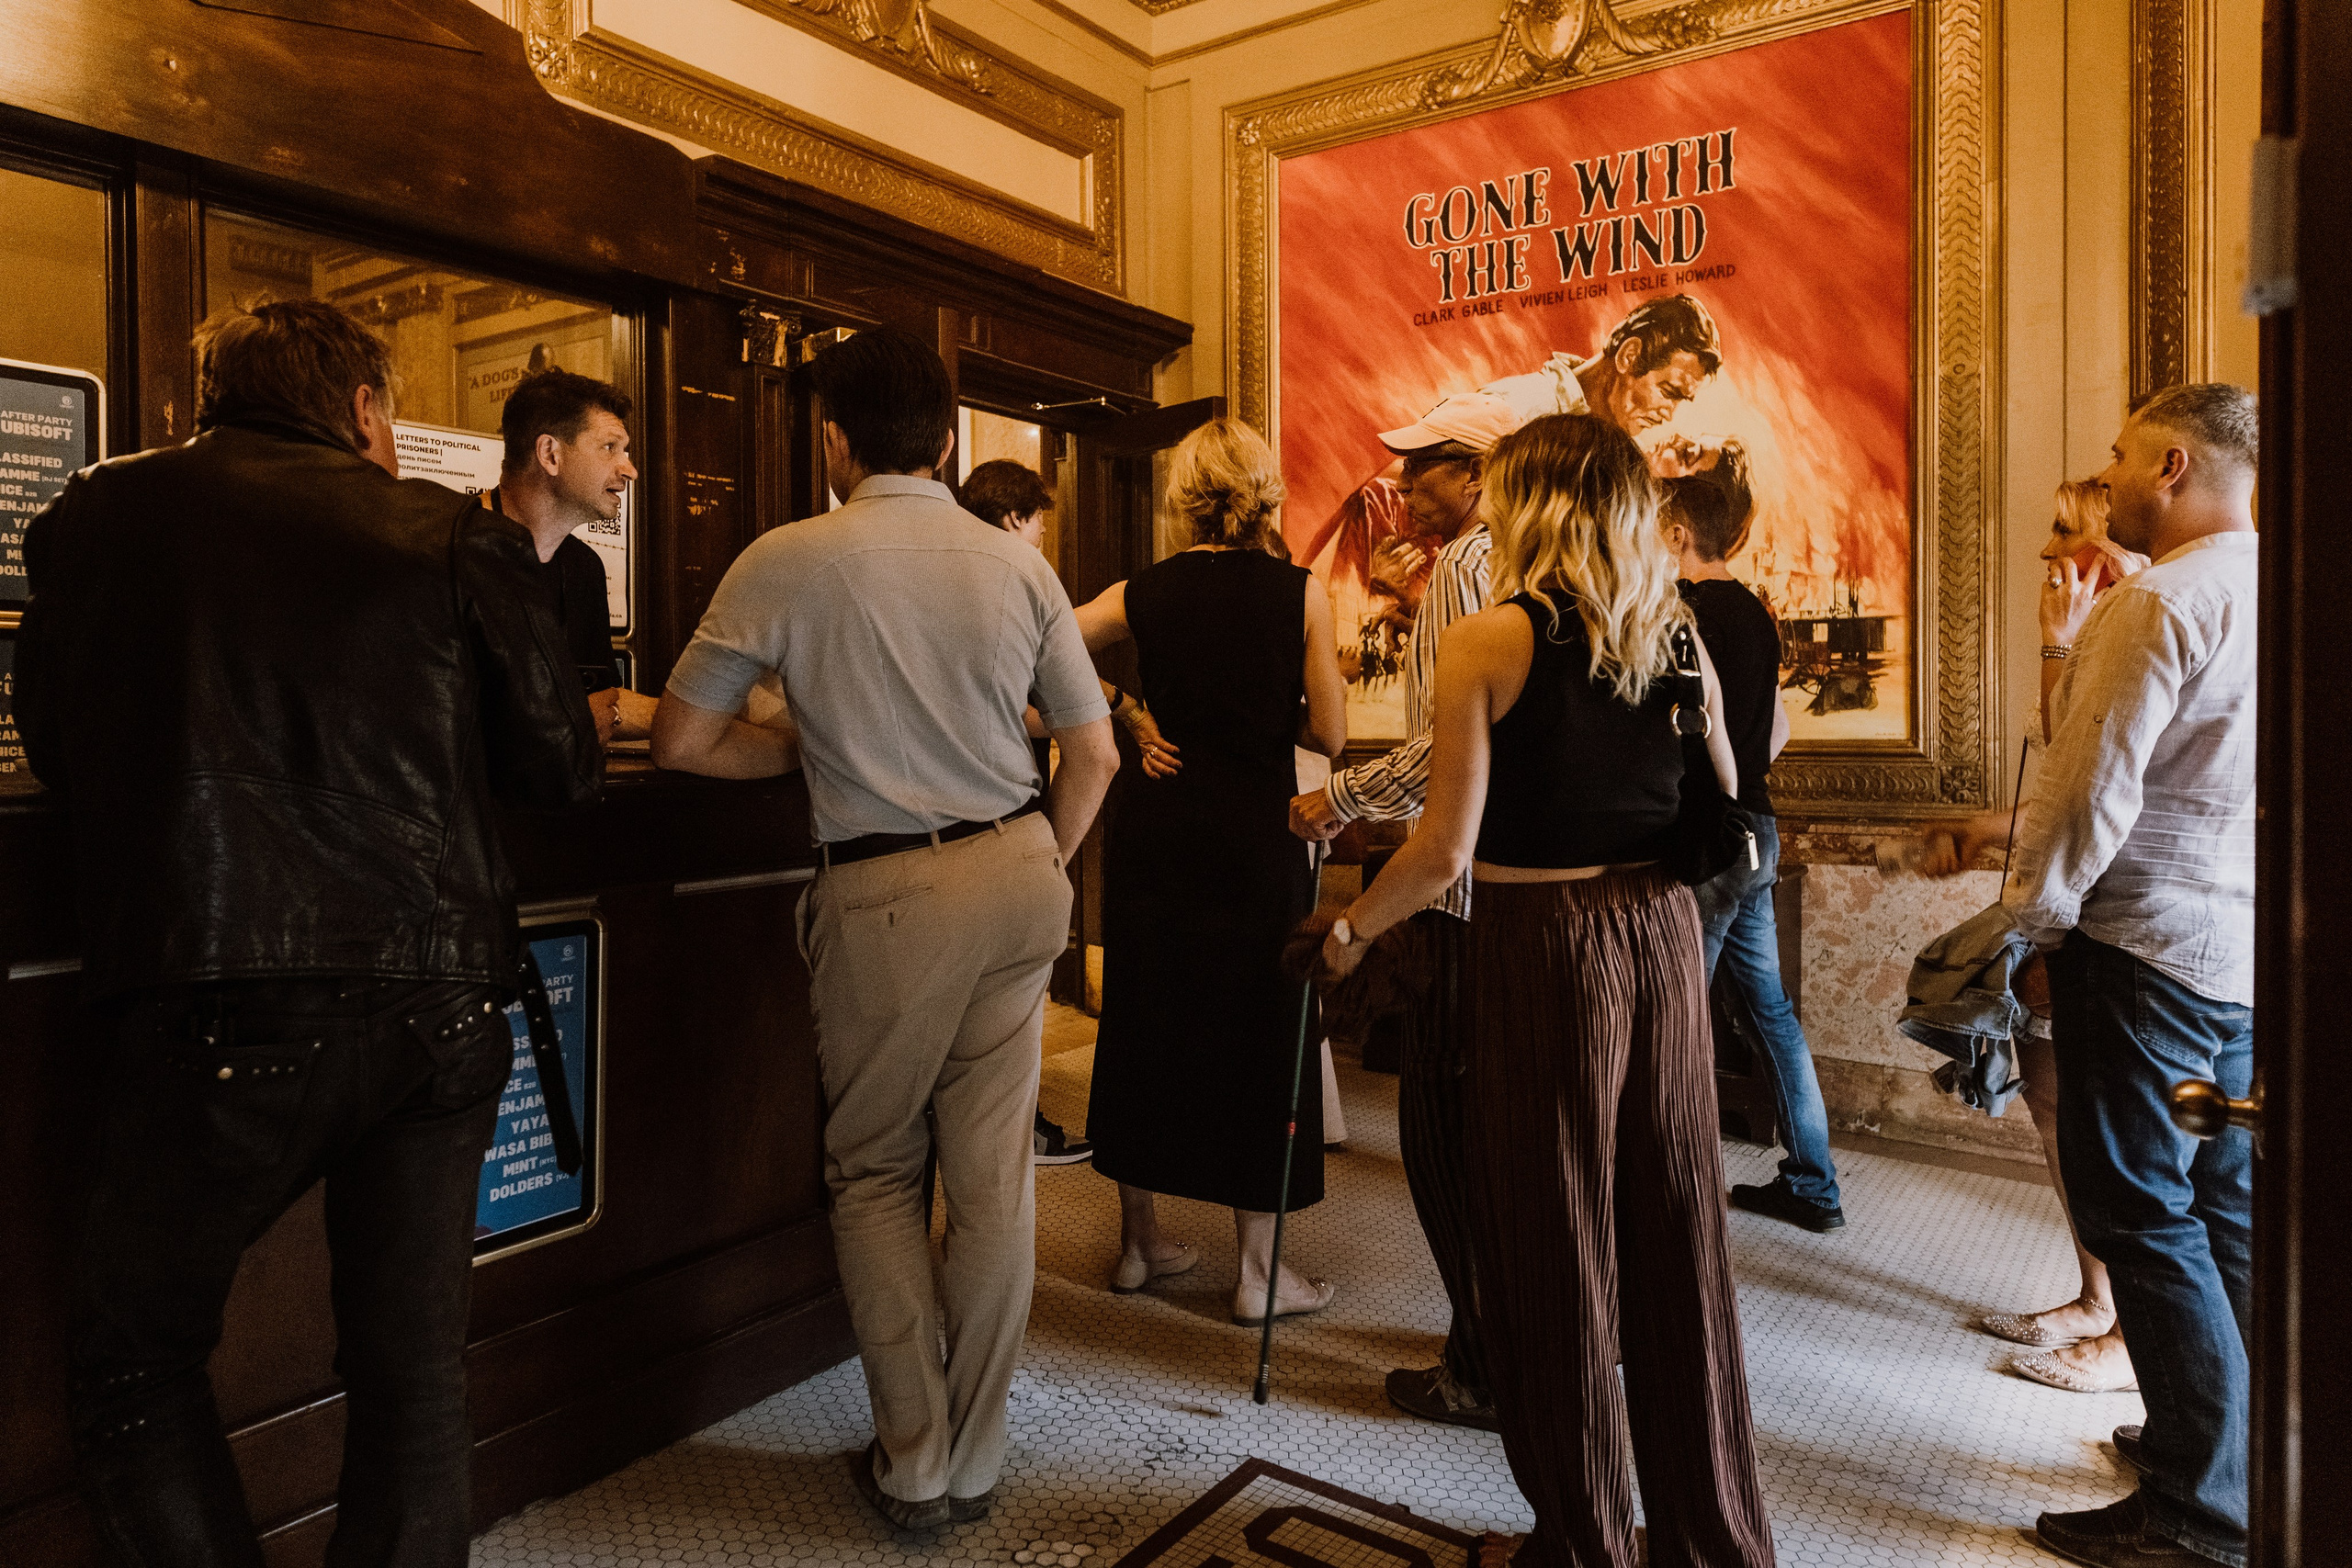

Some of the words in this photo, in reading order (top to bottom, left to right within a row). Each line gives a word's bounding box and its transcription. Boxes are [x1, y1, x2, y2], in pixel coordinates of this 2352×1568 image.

[1403, 167, 1551, 249] GONE
[1571, 127, 1737, 218] WITH
[1430, 233, 1531, 304] THE
[1550, 203, 1708, 284] WIND
[1413, 308, 1454, 326] CLARK
[1462, 299, 1503, 318] GABLE
[1520, 289, 1564, 309] VIVIEN
[1567, 284, 1608, 301] LEIGH
[1623, 274, 1668, 293] LESLIE
[1676, 264, 1736, 285] HOWARD
[1, 410, 35, 422] AFTER
[38, 414, 73, 426] PARTY
[1, 420, 73, 441] UBISOFT
[396, 434, 428, 445] LETTERS
[442, 440, 481, 451] POLITICAL
[396, 444, 439, 455] PRISONERS
[0, 452, 62, 468] ASSIFIED
[416, 457, 442, 465] писем
[544, 975, 574, 987] ARTY
[511, 1113, 549, 1134] YAYA
[484, 1139, 526, 1163] WASA
[490, 1172, 553, 1202] DOLDERS
